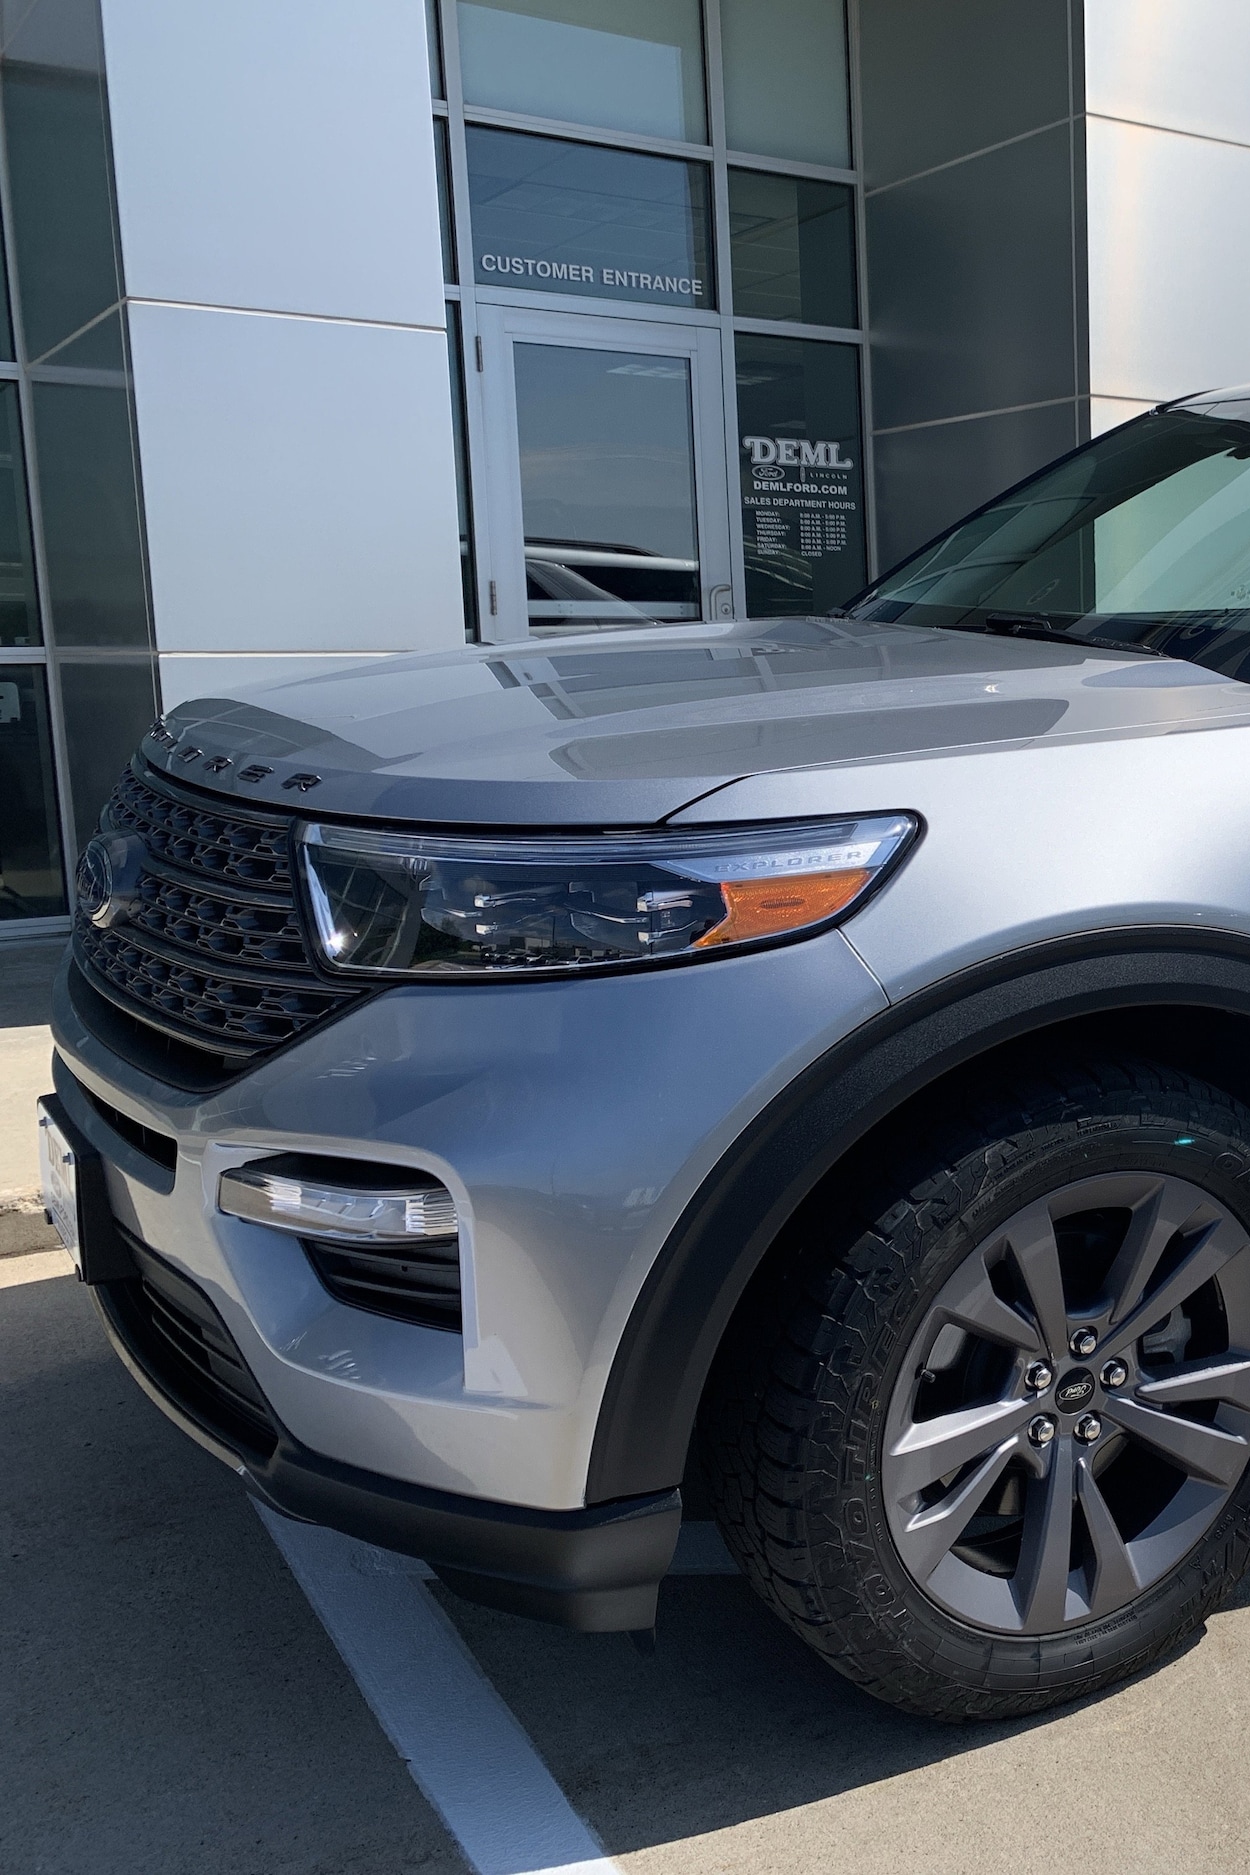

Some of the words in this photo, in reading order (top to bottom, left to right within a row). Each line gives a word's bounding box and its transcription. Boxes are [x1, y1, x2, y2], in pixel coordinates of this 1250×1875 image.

[481, 254, 594, 283] CUSTOMER
[602, 268, 703, 296] ENTRANCE
[742, 435, 853, 470] DEML
[810, 472, 848, 480] LINCOLN
[753, 480, 848, 495] DEMLFORD.COM
[744, 496, 771, 506] SALES
[772, 498, 827, 508] DEPARTMENT
[828, 501, 856, 510] HOURS
[713, 850, 864, 874] EXPLORER
